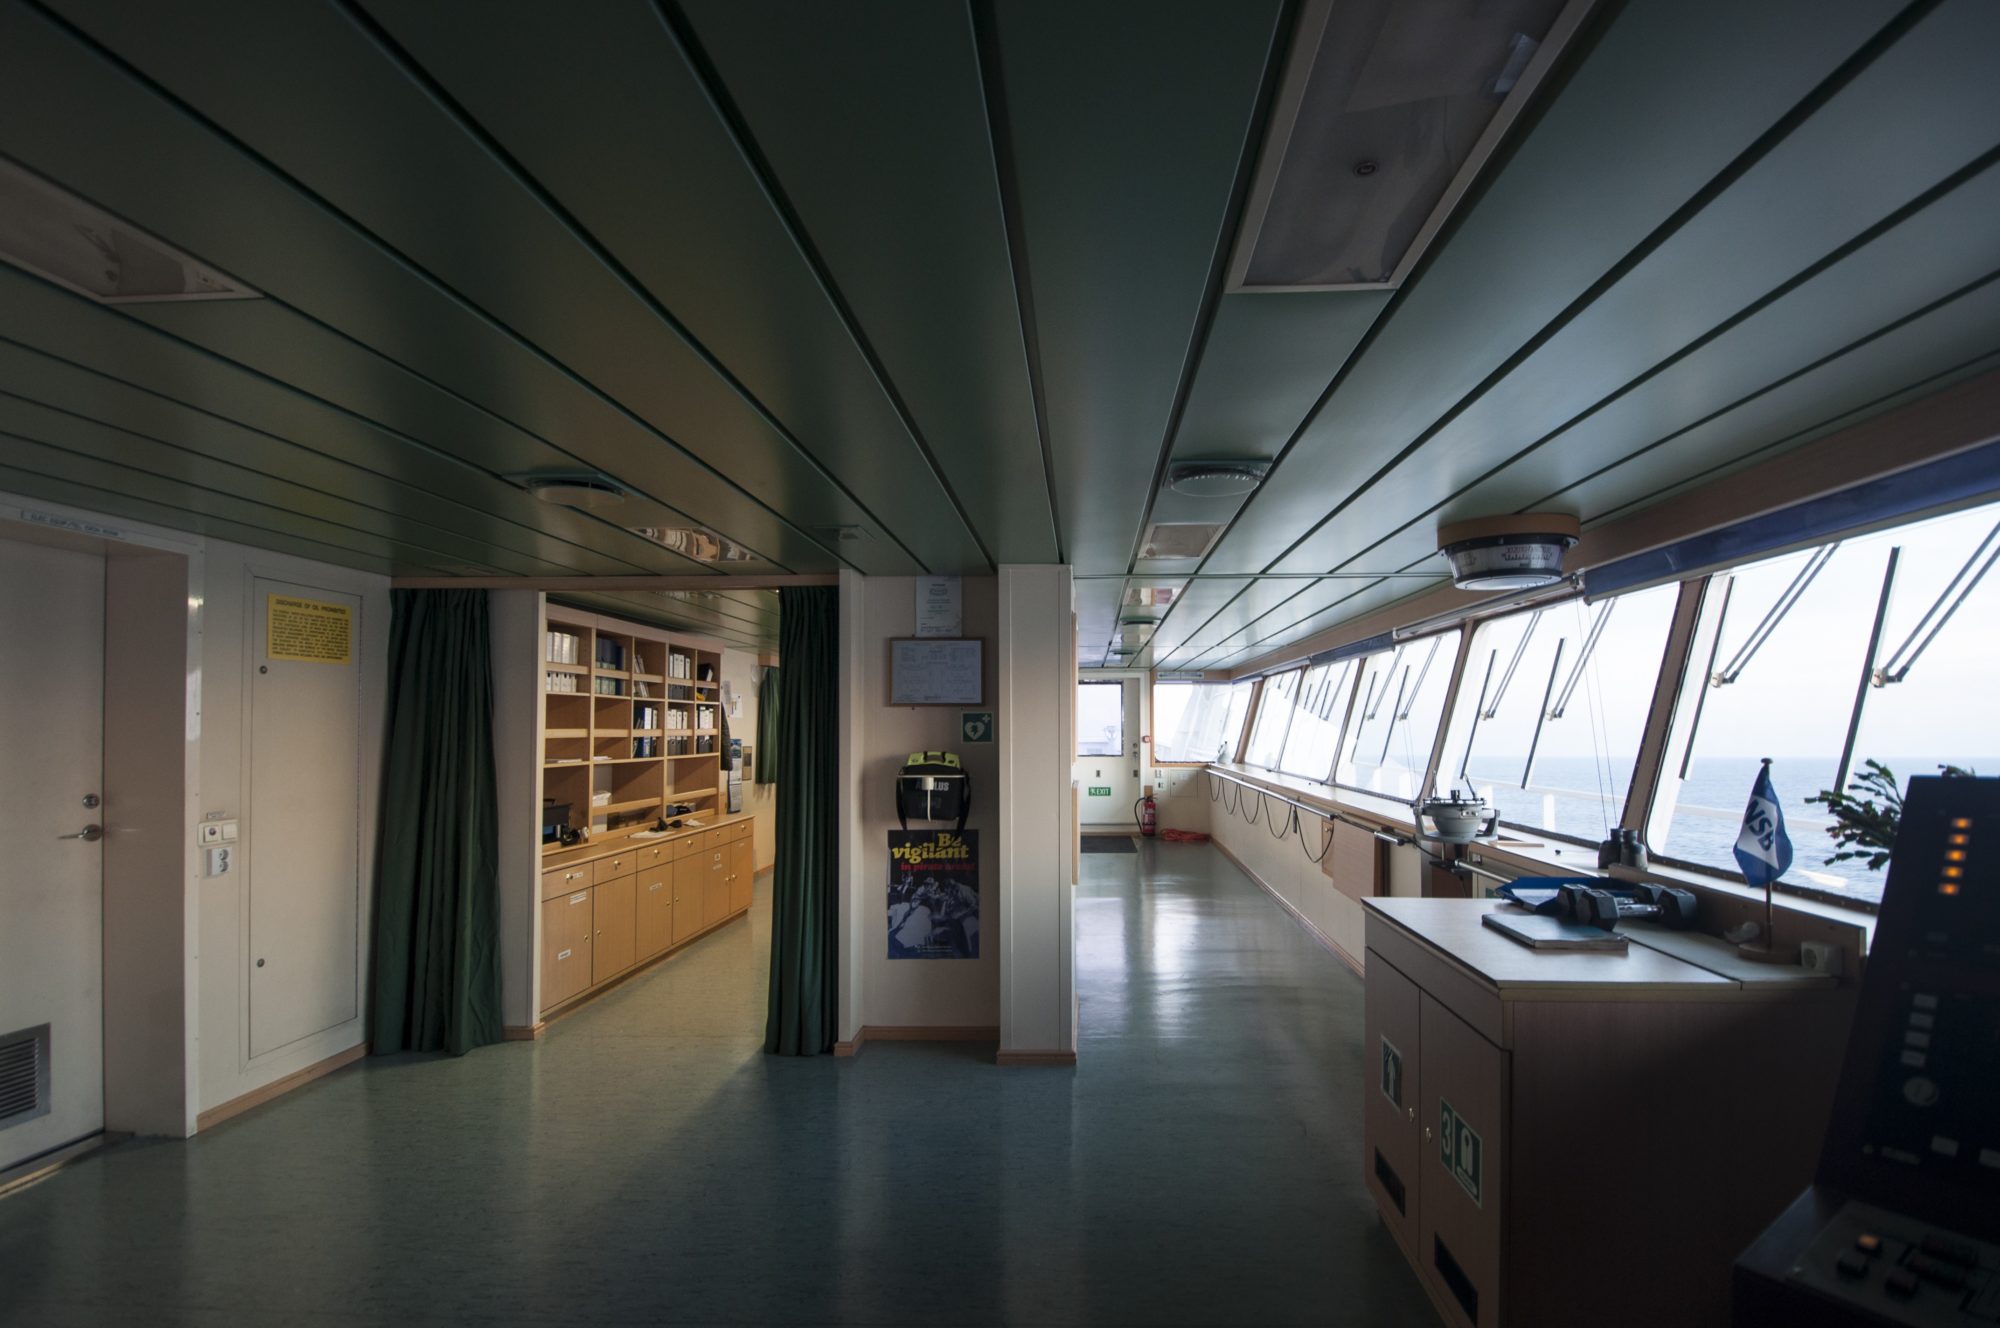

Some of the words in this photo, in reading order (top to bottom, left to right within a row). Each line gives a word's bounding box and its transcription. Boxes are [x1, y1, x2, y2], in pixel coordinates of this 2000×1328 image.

[933, 782, 950, 791] LUS
[1745, 799, 1774, 851] NSB
[938, 832, 961, 847] Be
[892, 842, 969, 865] vigilant
[1442, 1111, 1452, 1156] 3
